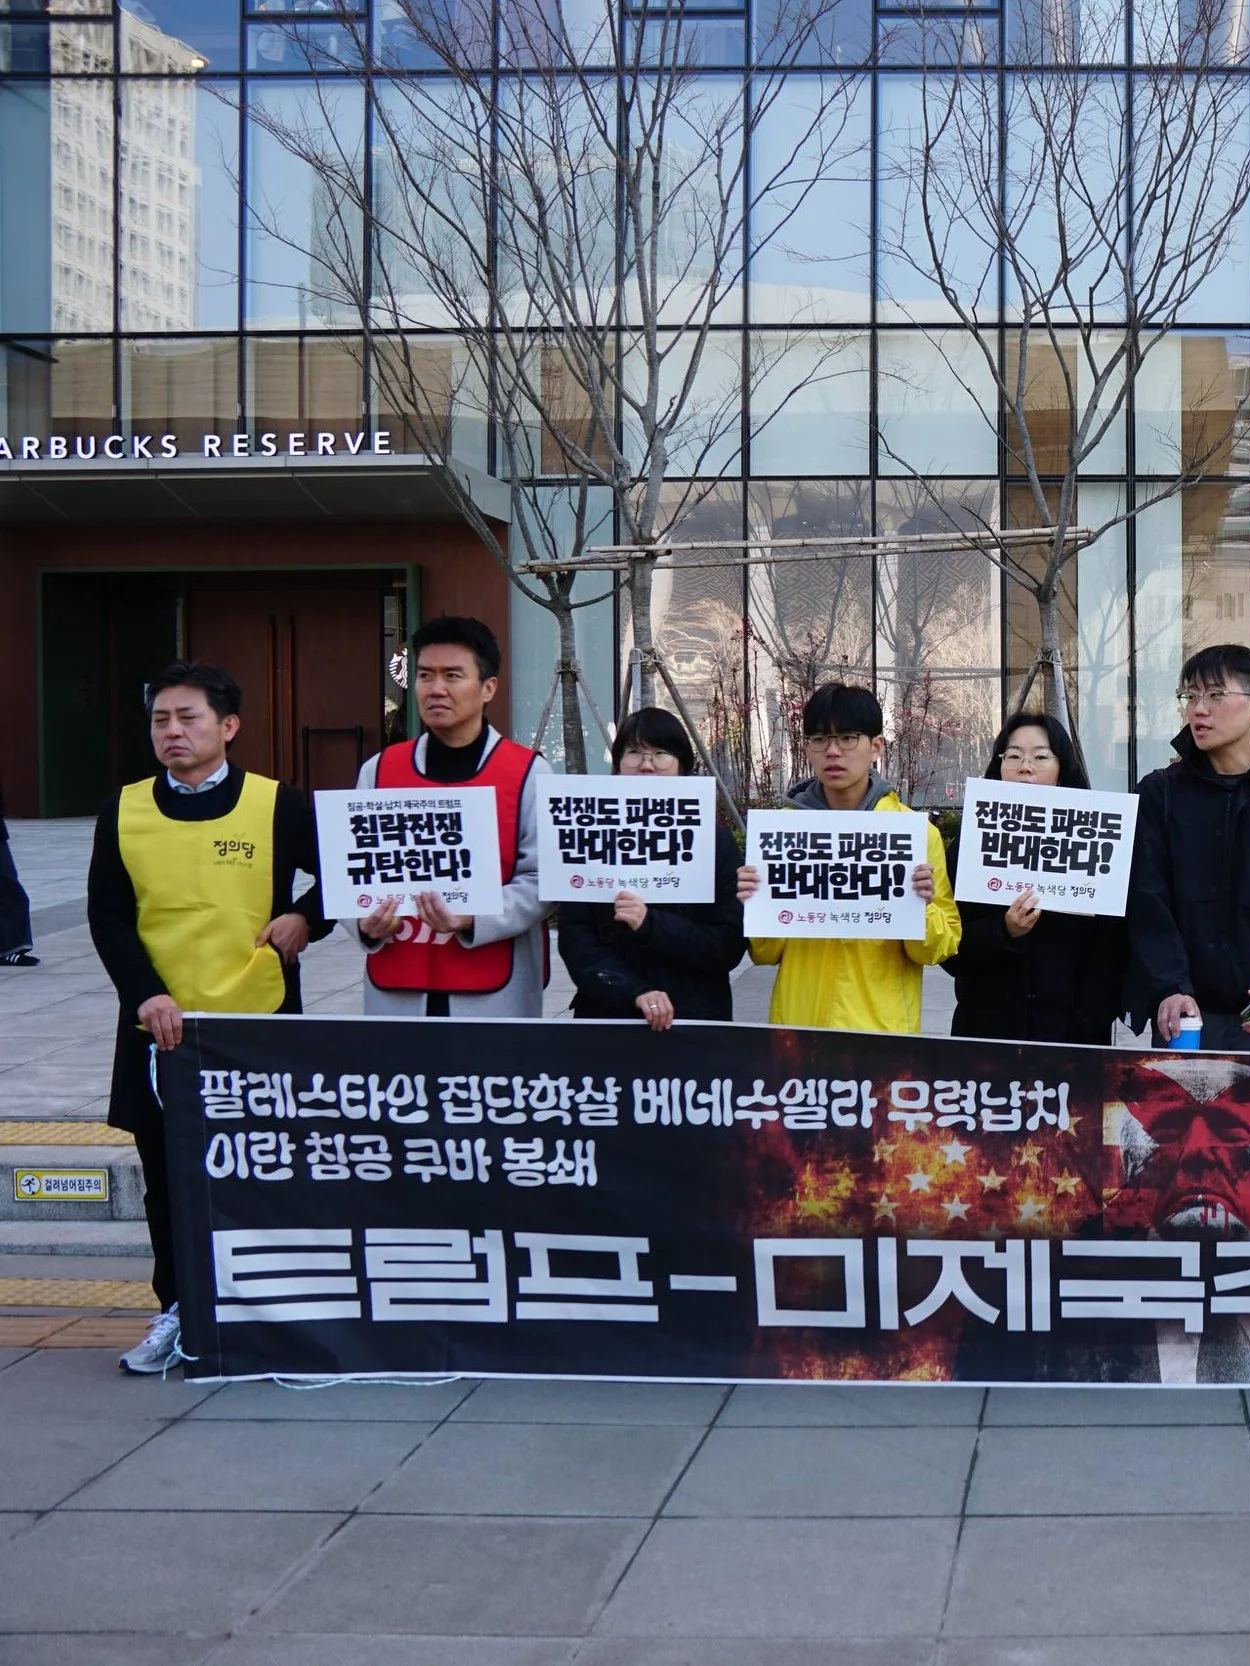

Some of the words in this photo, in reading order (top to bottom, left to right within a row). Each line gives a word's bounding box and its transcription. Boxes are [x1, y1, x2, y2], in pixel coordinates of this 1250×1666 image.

[203, 431, 392, 457] RESERVE
[404, 800, 436, 809] 제국주의
[438, 799, 462, 809] 트럼프
[549, 797, 620, 826] 전쟁도
[626, 798, 701, 829] 파병도
[350, 812, 465, 850] 침략전쟁
[975, 801, 1046, 834] 전쟁도
[1049, 808, 1122, 842] 파병도
[213, 840, 256, 860] 정의당
[558, 826, 694, 865] 반대한다!
[759, 832, 833, 861] 전쟁도
[836, 832, 913, 864] 파병도
[981, 830, 1116, 880] 반대한다!
[347, 846, 471, 885] 규탄한다!
[768, 860, 909, 901] 반대한다!
[442, 892, 468, 903] 정의당
[587, 878, 614, 888] 노동당
[618, 878, 649, 888] 녹색당
[653, 877, 680, 888] 정의당
[1004, 880, 1036, 894] 노동당
[1037, 884, 1067, 896] 녹색당
[1070, 886, 1095, 898] 정의당
[797, 912, 827, 923] 노동당
[830, 912, 861, 923] 녹색당
[865, 912, 892, 923] 정의당
[200, 1070, 429, 1123] 팔레스타인
[438, 1073, 622, 1126] 집단학살
[633, 1078, 877, 1129] 베네수엘라
[888, 1080, 1072, 1134] 무력납치
[206, 1132, 296, 1180] 이란
[305, 1132, 392, 1180] 침공
[404, 1138, 492, 1182] 쿠바
[502, 1137, 597, 1186] 봉쇄
[44, 1178, 102, 1192] 걸려넘어짐주의
